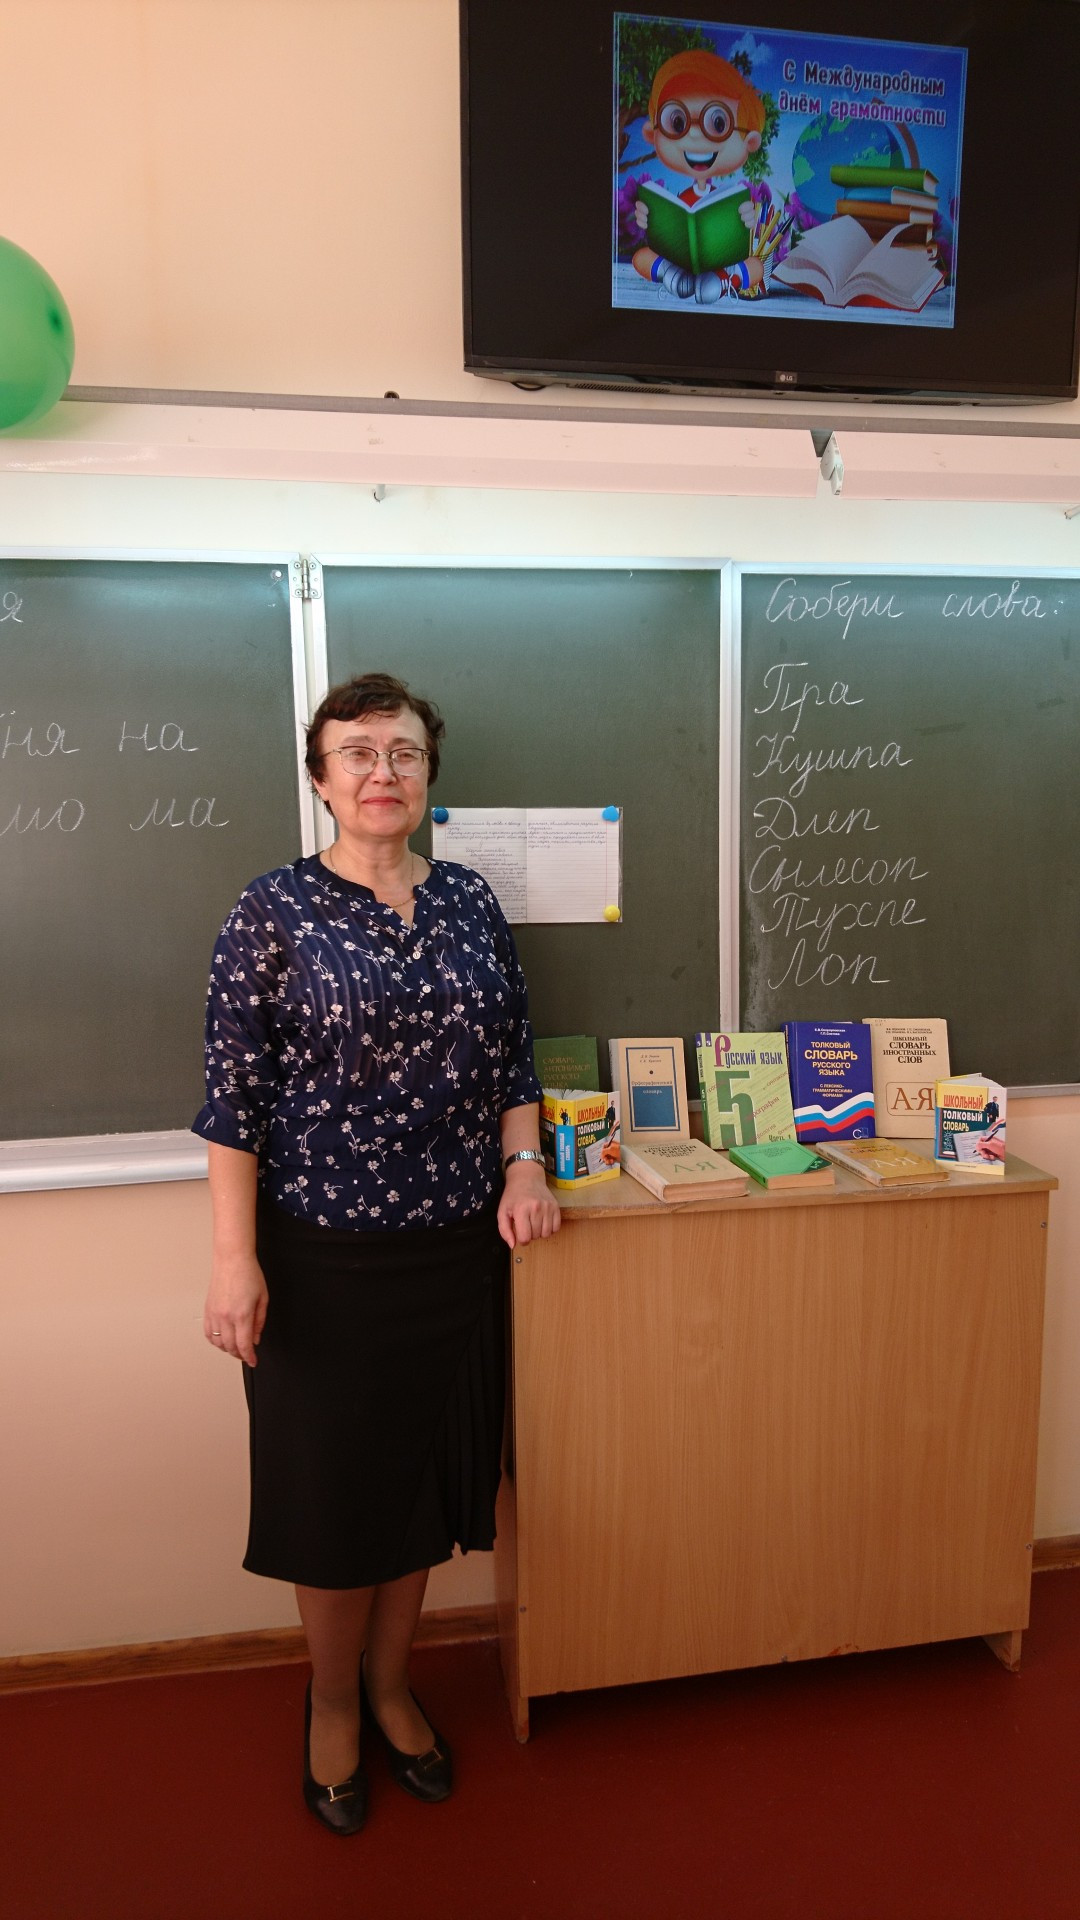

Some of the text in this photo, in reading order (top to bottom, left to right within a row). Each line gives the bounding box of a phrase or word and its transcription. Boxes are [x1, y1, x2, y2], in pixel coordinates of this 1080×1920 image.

[783, 59, 945, 96] С Международным
[778, 90, 946, 127] днём грамотности
[766, 578, 1063, 639] Собери слова:
[754, 662, 864, 733] Пра
[118, 721, 198, 752] на
[129, 797, 229, 831] ма
[767, 938, 890, 990] Лоп
[714, 1034, 757, 1068] Русский
[760, 1052, 784, 1065] язык
[804, 1049, 858, 1060] СЛОВАРЬ
[811, 1041, 850, 1049] ТОЛКОВЫЙ
[889, 1041, 931, 1050] СЛОВАРЬ
[812, 1061, 851, 1069] РУССКОГО
[897, 1055, 923, 1064] СЛОВ
[891, 1087, 935, 1111] А-Я
[943, 1094, 984, 1109] ШКОЛЬНЫЙ
[714, 1071, 758, 1148] 5
[943, 1110, 983, 1122] ТОЛКОВЫЙ
[577, 1119, 605, 1136] ТОЛКОВЫЙ
[943, 1121, 970, 1131] СЛОВАРЬ
[577, 1134, 597, 1147] СЛОВАРЬ
